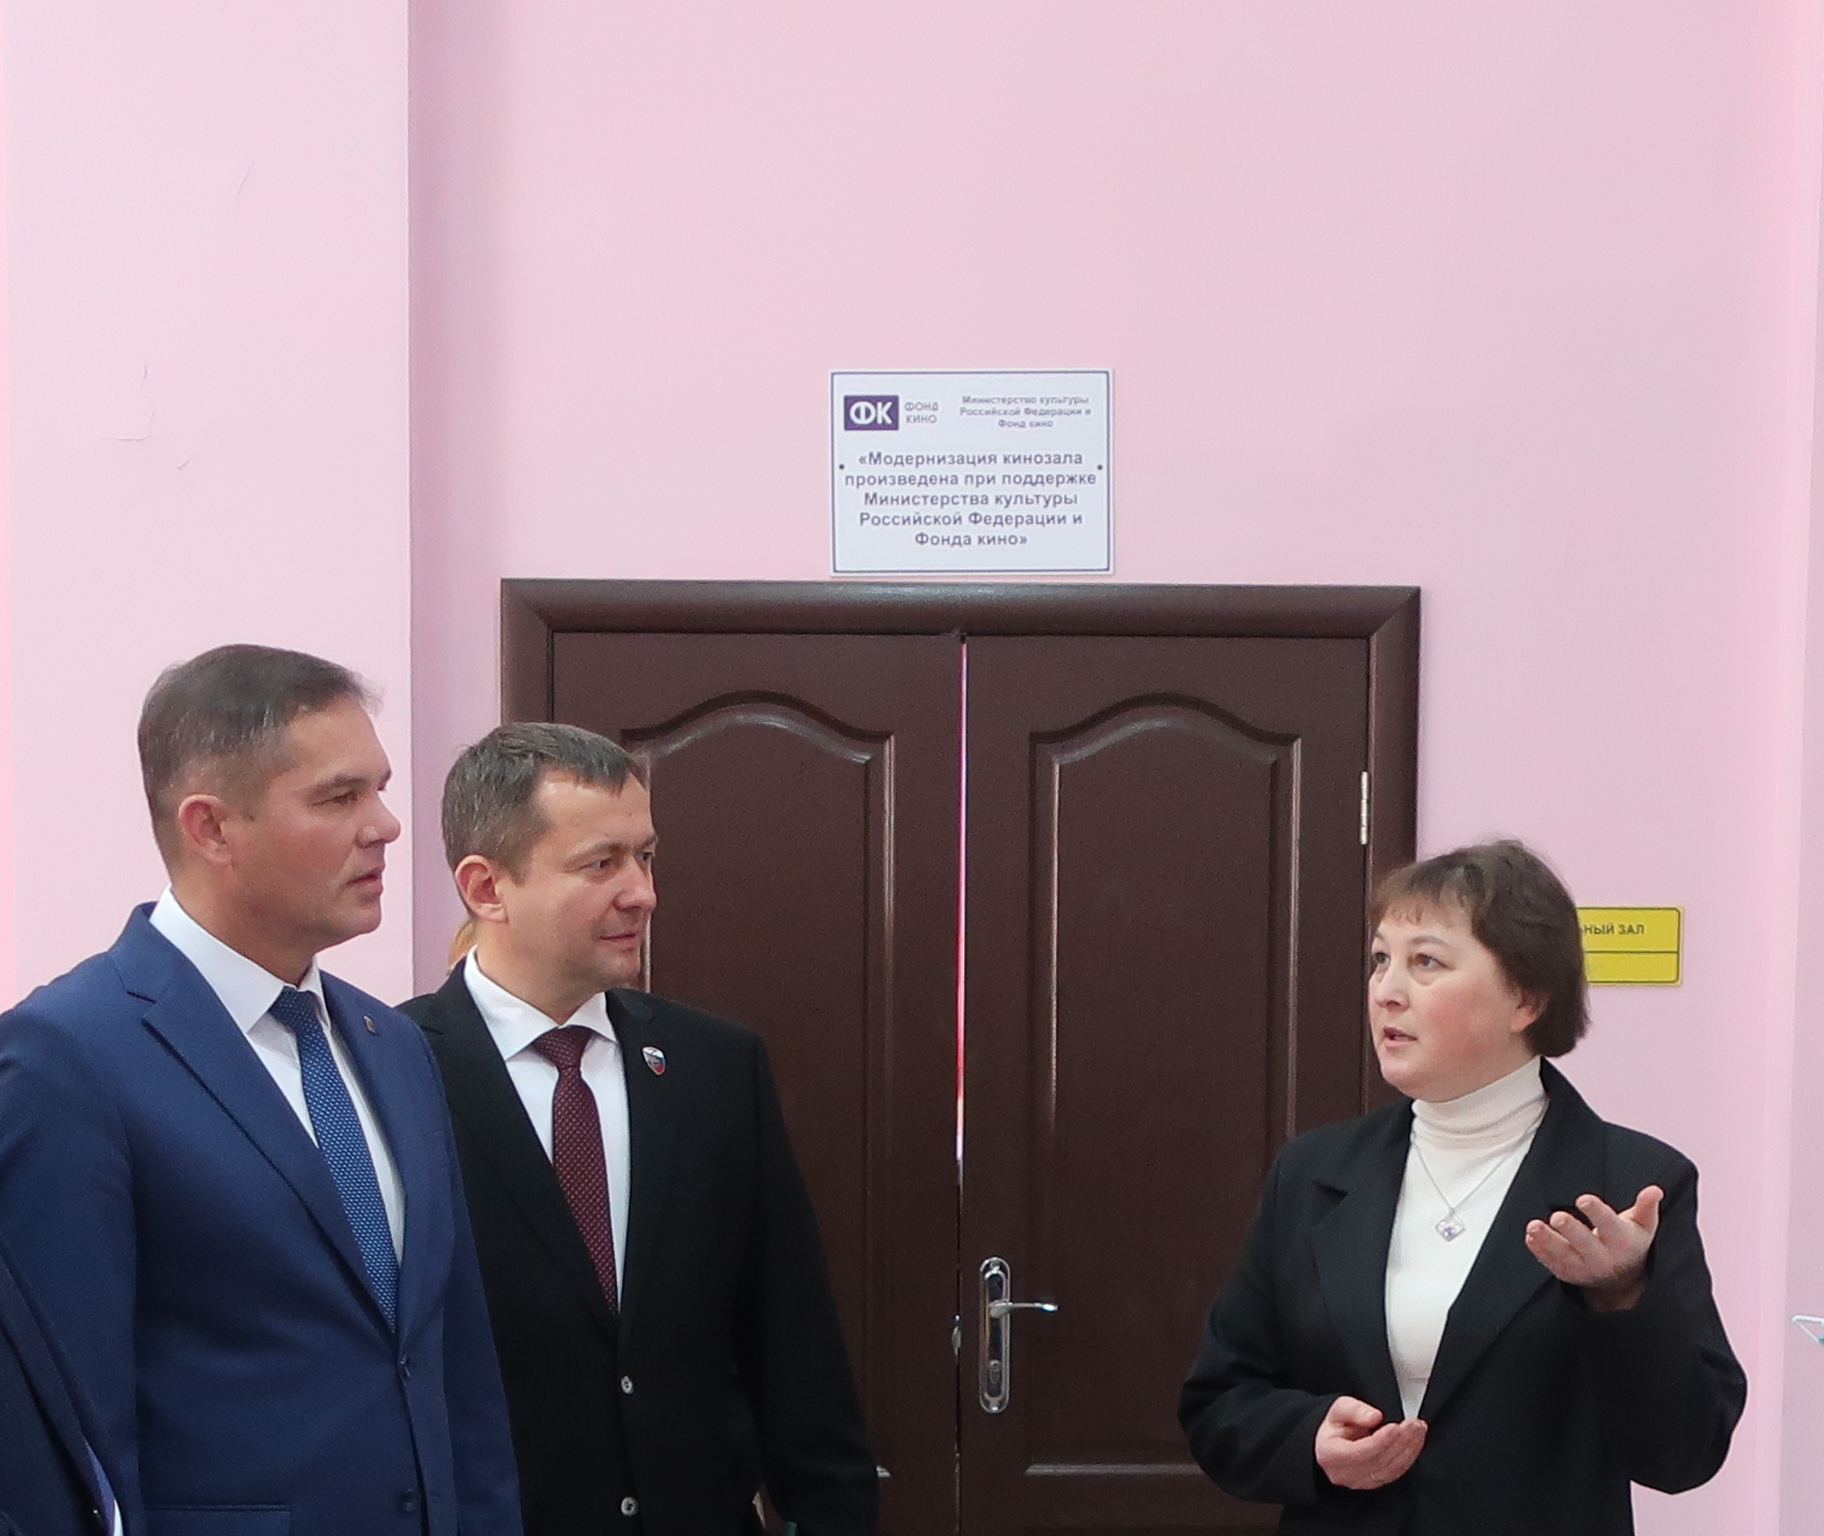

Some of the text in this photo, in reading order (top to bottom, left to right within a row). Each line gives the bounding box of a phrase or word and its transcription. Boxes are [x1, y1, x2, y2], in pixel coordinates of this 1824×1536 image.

[904, 400, 939, 413] ФОНД
[962, 394, 1089, 407] Министерство культуры
[850, 401, 894, 426] ФК
[905, 413, 938, 425] КИНО
[959, 406, 1092, 418] Российской Федерации и
[997, 418, 1054, 430] Фонд кино
[858, 451, 1083, 469] «Модернизация кинозала
[844, 471, 1097, 489] произведена при поддержке
[863, 491, 1079, 509] Министерства культуры
[859, 511, 1083, 530] Российской Федерации и
[914, 531, 1028, 549] Фонда кино»
[1618, 924, 1644, 935] ЗАЛ
